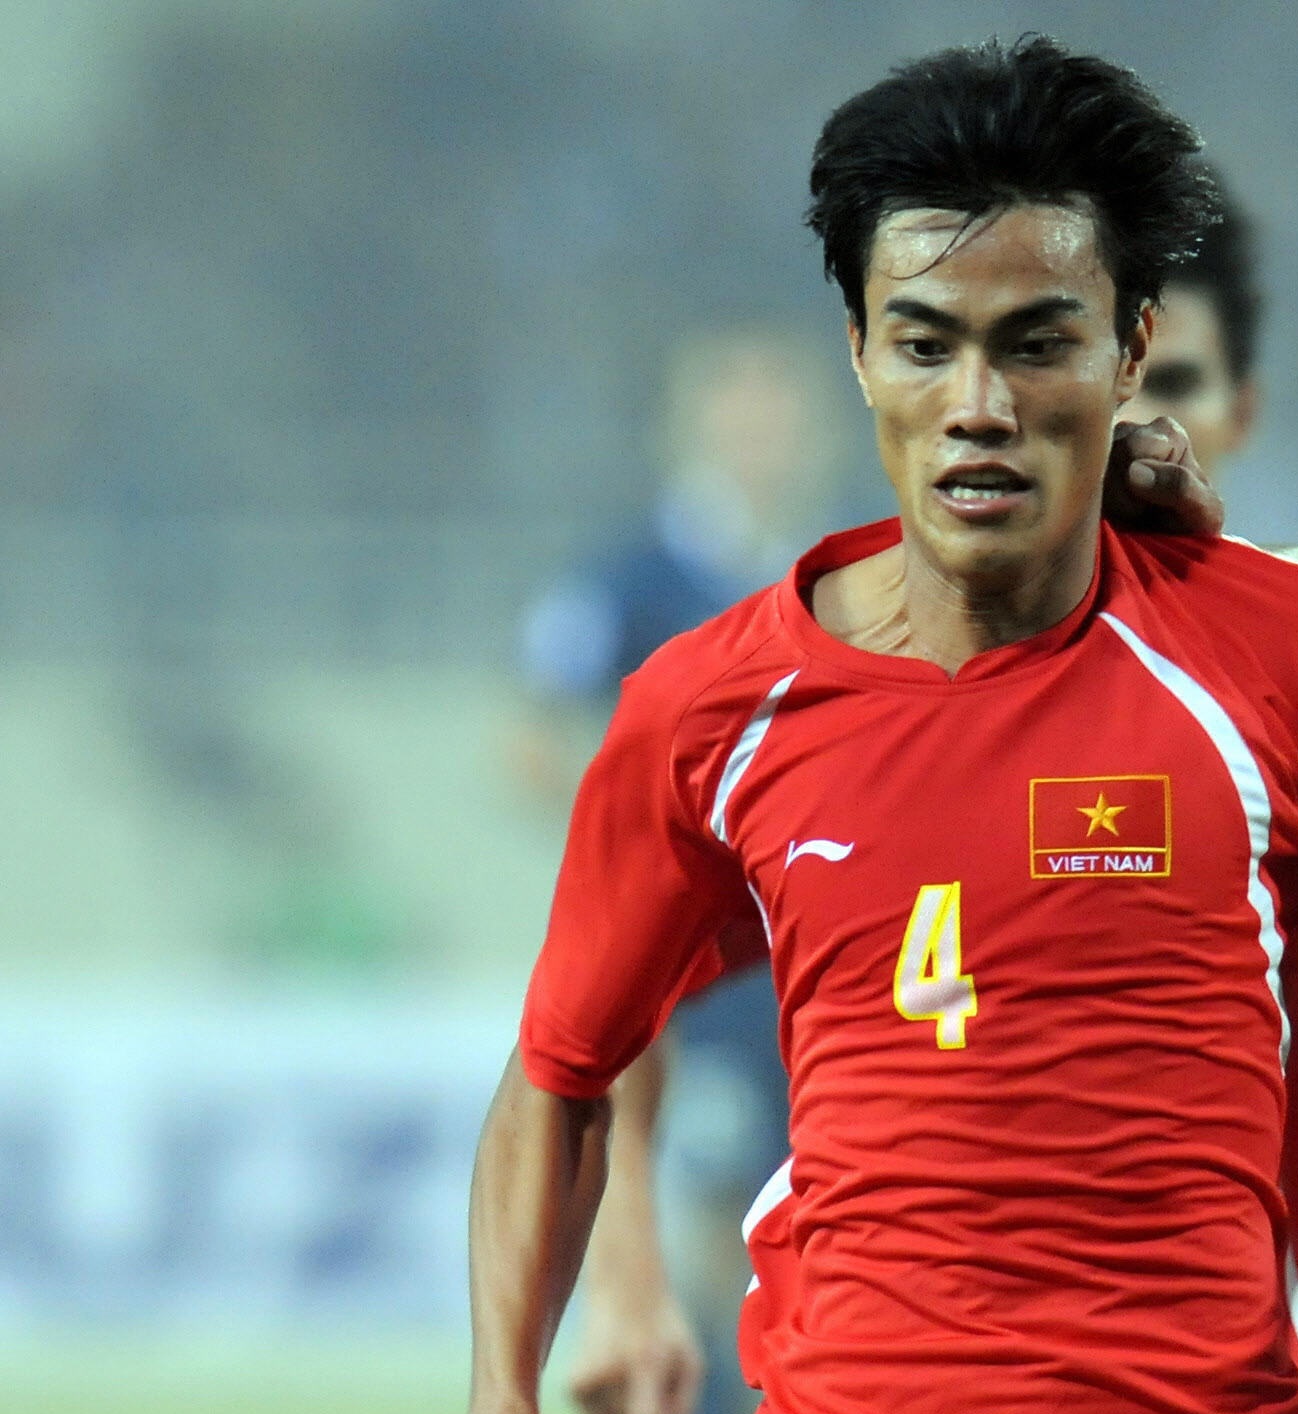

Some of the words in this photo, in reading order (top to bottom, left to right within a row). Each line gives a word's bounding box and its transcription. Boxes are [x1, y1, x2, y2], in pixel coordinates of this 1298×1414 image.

[1048, 855, 1099, 872] VIET
[1104, 854, 1153, 872] NAM
[894, 881, 977, 1049] 4
